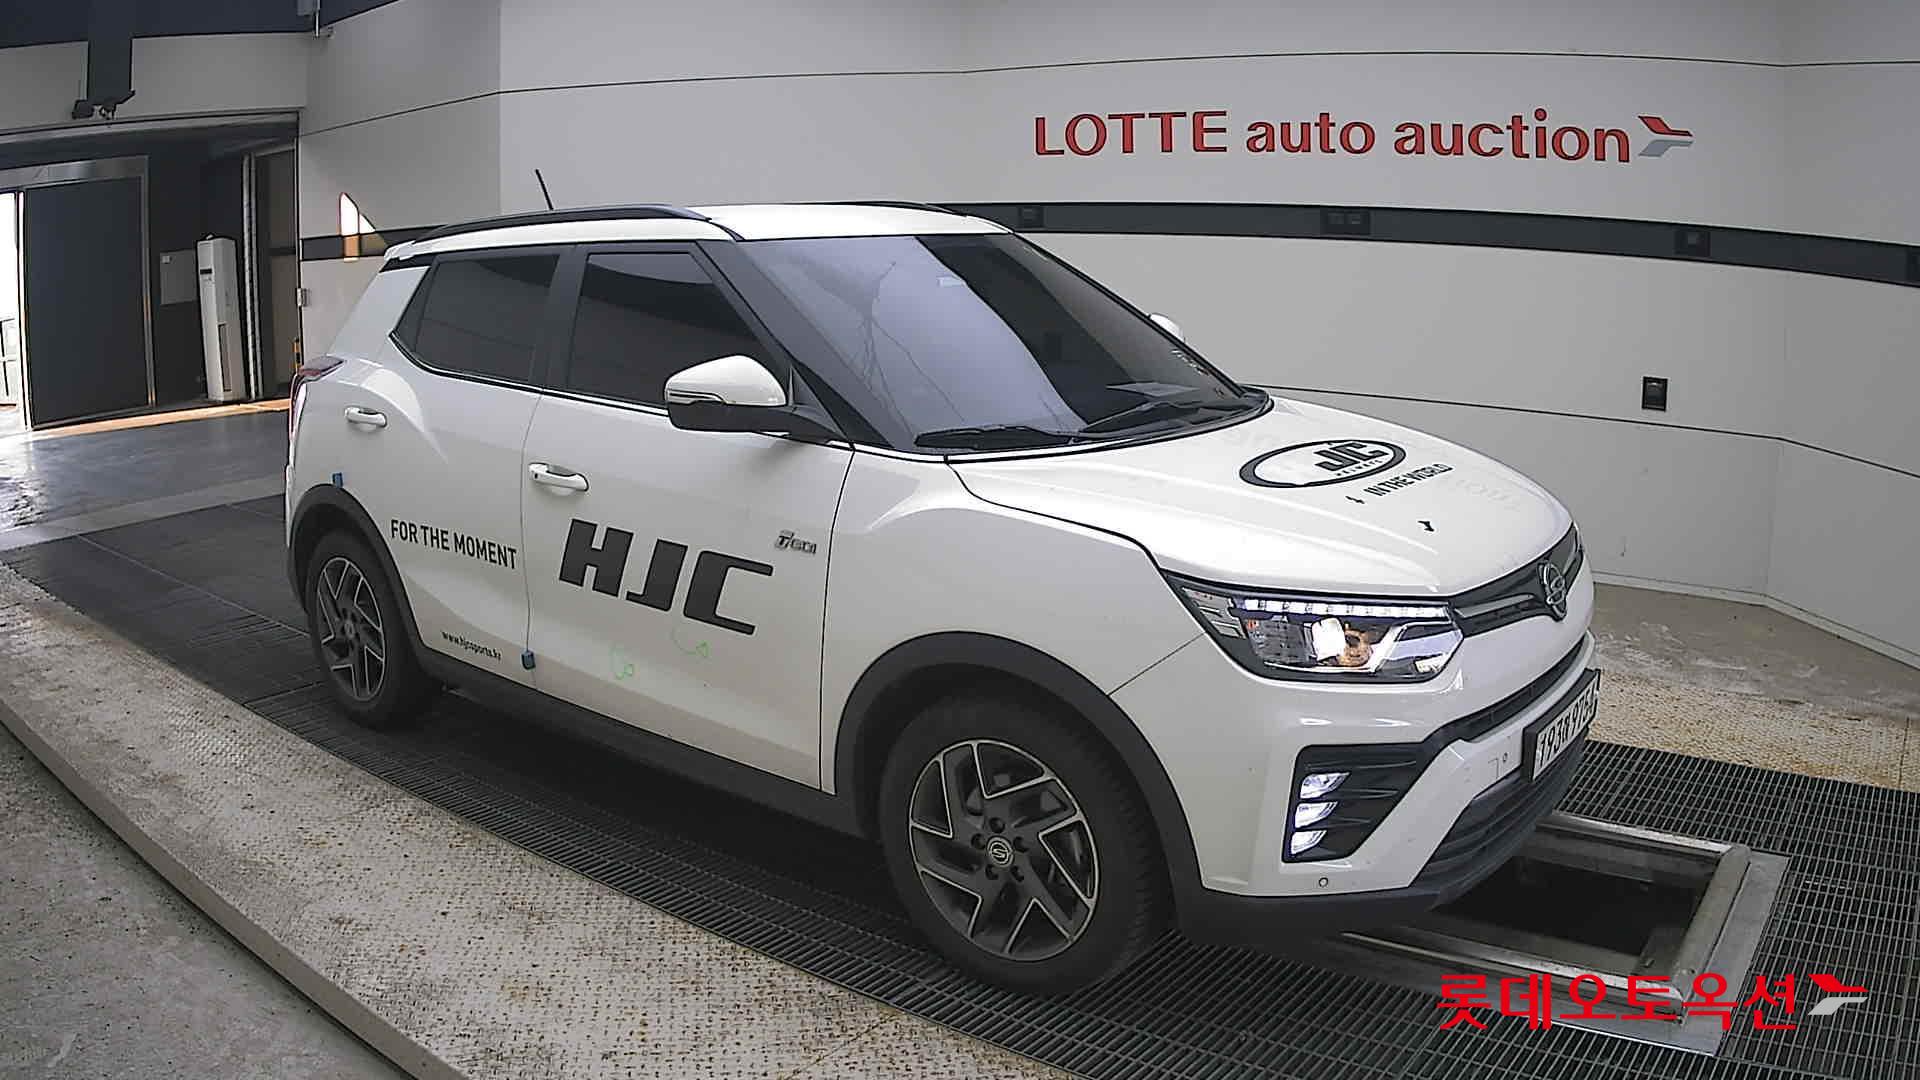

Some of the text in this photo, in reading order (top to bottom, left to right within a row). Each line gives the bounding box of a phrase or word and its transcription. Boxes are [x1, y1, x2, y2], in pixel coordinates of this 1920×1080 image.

[1035, 107, 1630, 163] LOTTE auto auction
[391, 519, 516, 569] FOR THE MOMENT
[559, 518, 773, 635] HJC
